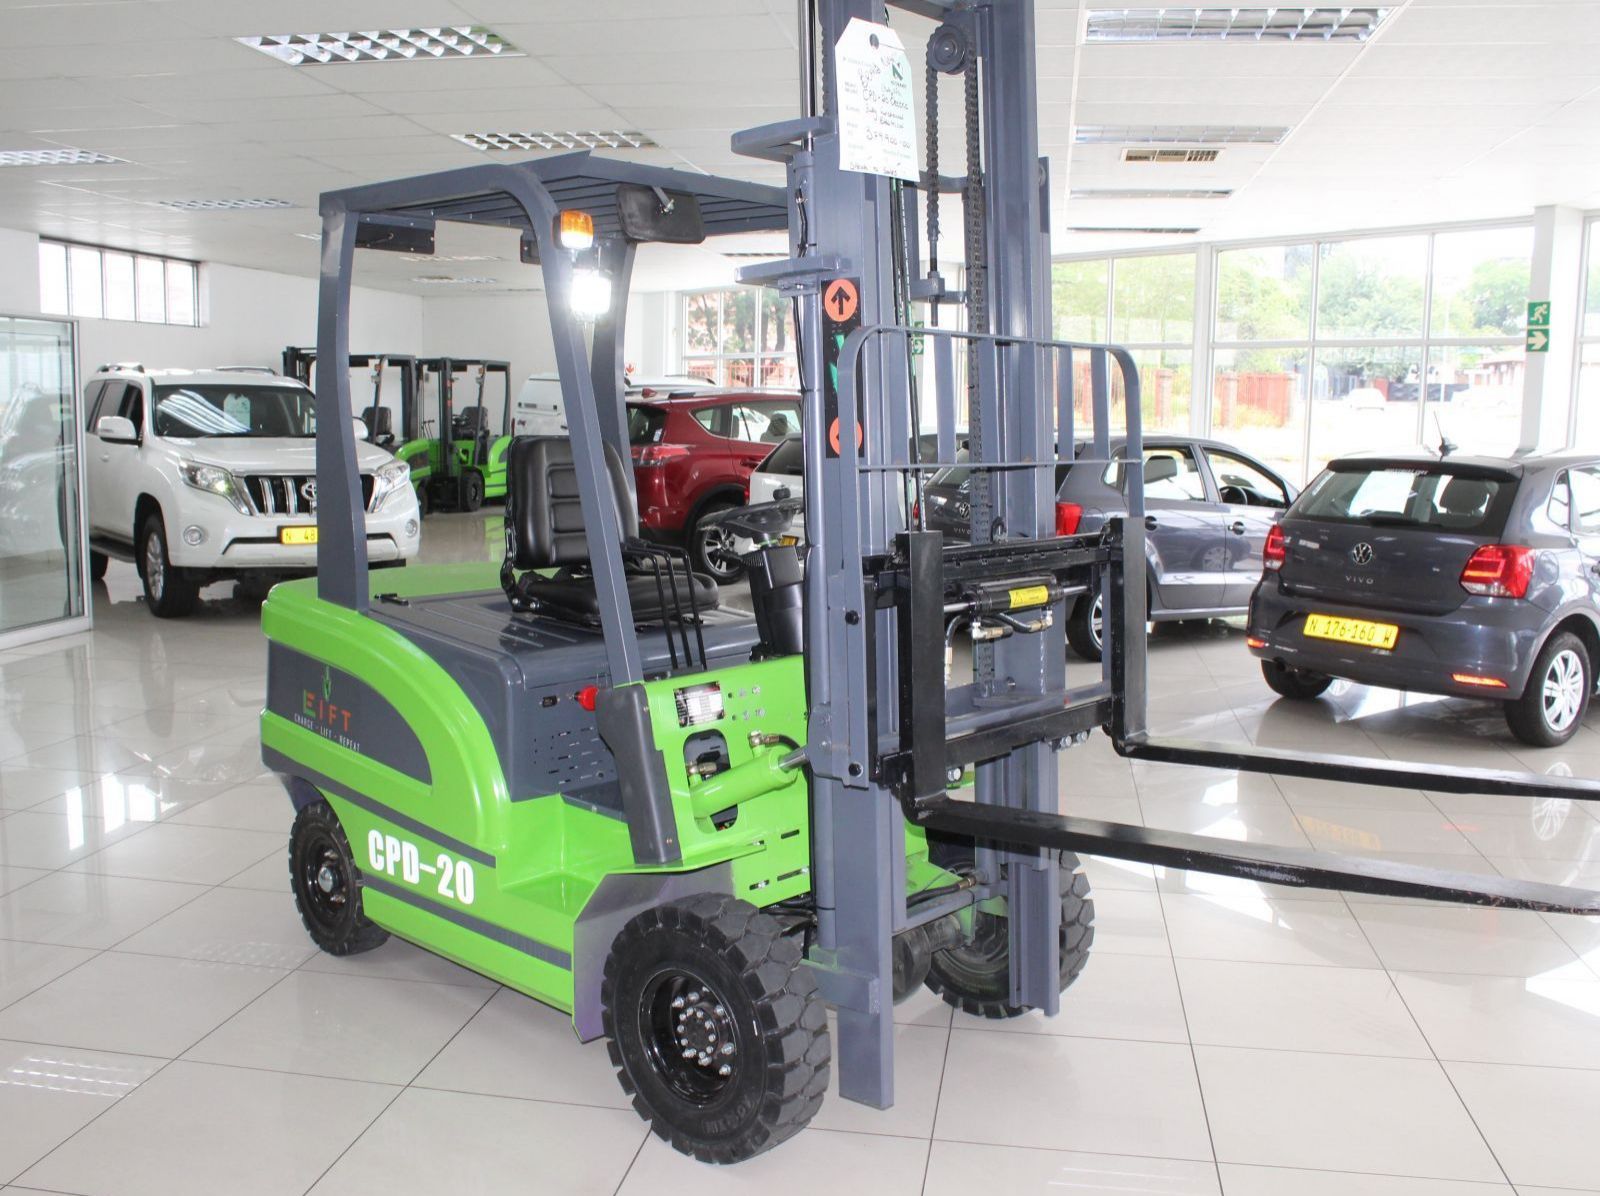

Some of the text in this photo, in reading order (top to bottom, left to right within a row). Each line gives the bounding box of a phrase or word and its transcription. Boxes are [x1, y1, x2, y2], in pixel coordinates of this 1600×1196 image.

[1345, 575, 1374, 585] VIVO
[1309, 617, 1393, 644] N 176-160 W
[294, 712, 361, 752] CHARGE LIFT REPEAT
[367, 829, 475, 905] CPD-20
